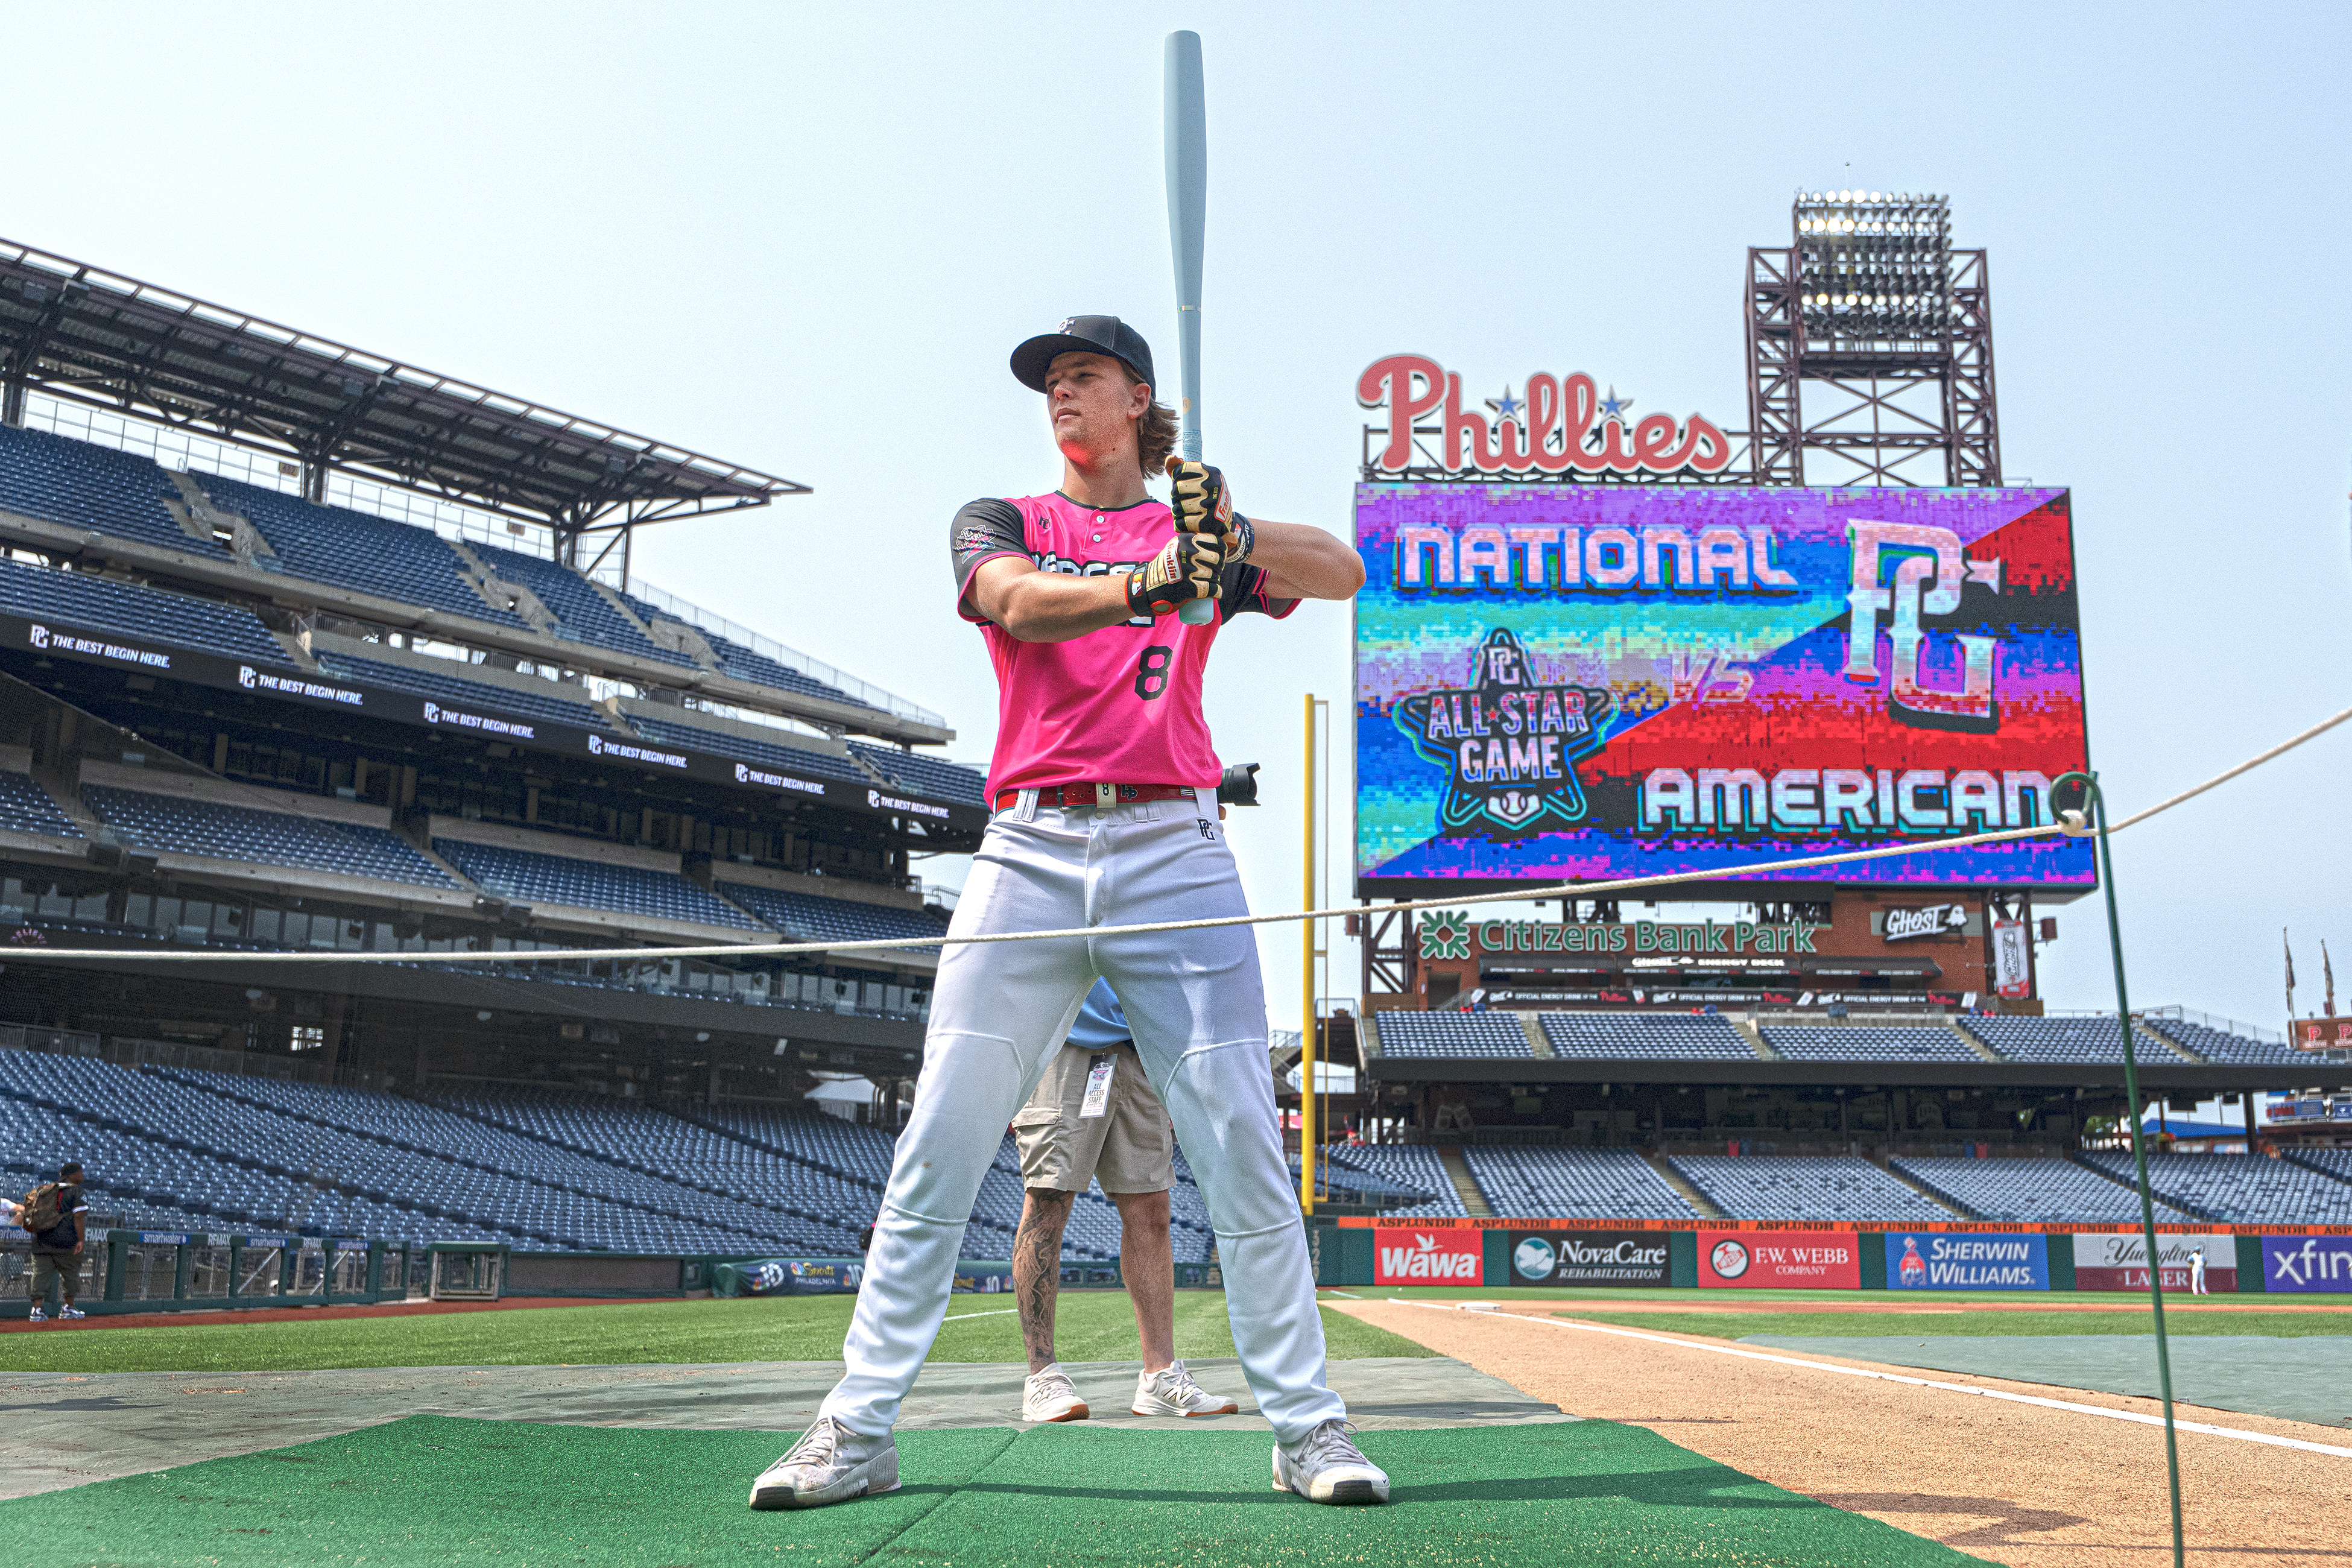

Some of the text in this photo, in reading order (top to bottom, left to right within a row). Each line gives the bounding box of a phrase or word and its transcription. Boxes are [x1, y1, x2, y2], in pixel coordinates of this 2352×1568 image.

[1357, 354, 1730, 473] Phillies
[1218, 490, 1230, 519] Frank
[1166, 543, 1177, 579] Franklin
[1402, 525, 1799, 586] NATIONAL
[53, 634, 75, 650] THE
[75, 638, 104, 655] BEST
[104, 644, 139, 662] BEGIN
[1134, 645, 1173, 701] 8
[1673, 650, 1760, 702] VS
[259, 674, 279, 689] THE
[279, 678, 305, 693] BEST
[305, 684, 335, 700] BEGIN
[441, 710, 460, 724] THE
[460, 713, 482, 728] BEST
[482, 718, 510, 733] BEGIN
[1429, 691, 1589, 738] ALL STAR
[604, 742, 620, 755] THE
[620, 745, 640, 759] BEST
[640, 750, 665, 763] BEGIN
[1459, 737, 1561, 782] GAME
[749, 770, 764, 783] THE
[880, 796, 894, 808] THE
[1645, 768, 2053, 825] AMERICAN
[1886, 904, 1950, 941] GHOST
[1479, 917, 1816, 953] Citizens Bank Park
[1377, 1218, 1456, 1228] ASPLUNDH
[1472, 1219, 1550, 1229] ASPLUNDH
[1567, 1219, 1645, 1230] ASPLUNDH
[1661, 1220, 1740, 1230] ASPLUNDH
[1756, 1221, 1834, 1231] ASPLUNDH
[1850, 1222, 1929, 1231] ASPLUNDH
[1945, 1223, 2023, 1233] ASPLUNDH
[2040, 1224, 2118, 1234] ASPLUNDH
[2135, 1224, 2213, 1234] APLUNDH
[2230, 1225, 2307, 1234] ASPLUNDH
[144, 1233, 180, 1243] smartwater
[250, 1238, 281, 1247] smartwater
[1558, 1240, 1666, 1265] NovaCare
[1792, 1247, 1848, 1265] WEBB
[1930, 1238, 2029, 1260] SHERWIN
[2104, 1238, 2205, 1266] Yueglin
[803, 1262, 835, 1277] Sports
[1381, 1247, 1478, 1279] Wawa
[1775, 1265, 1827, 1276] COMPANY
[1558, 1268, 1663, 1280] REHABILITATION
